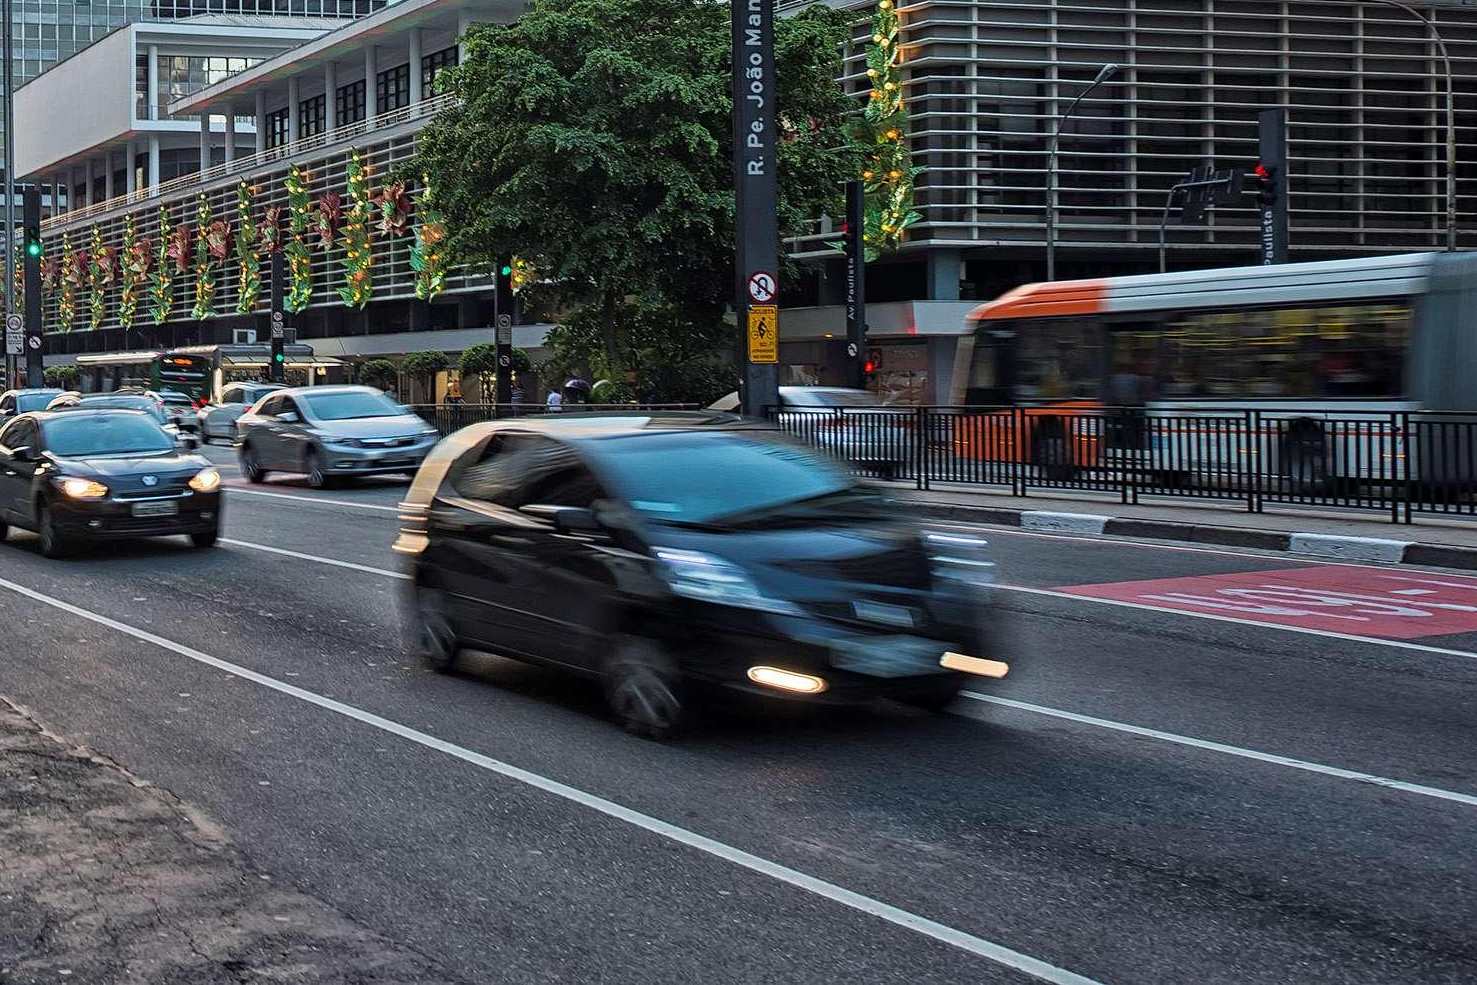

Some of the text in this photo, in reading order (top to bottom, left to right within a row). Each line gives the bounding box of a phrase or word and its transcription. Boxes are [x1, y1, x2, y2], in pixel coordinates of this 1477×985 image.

[745, 52, 764, 109] João
[747, 117, 764, 148] Pe.
[747, 155, 764, 175] R.
[847, 257, 855, 303] Paulista
